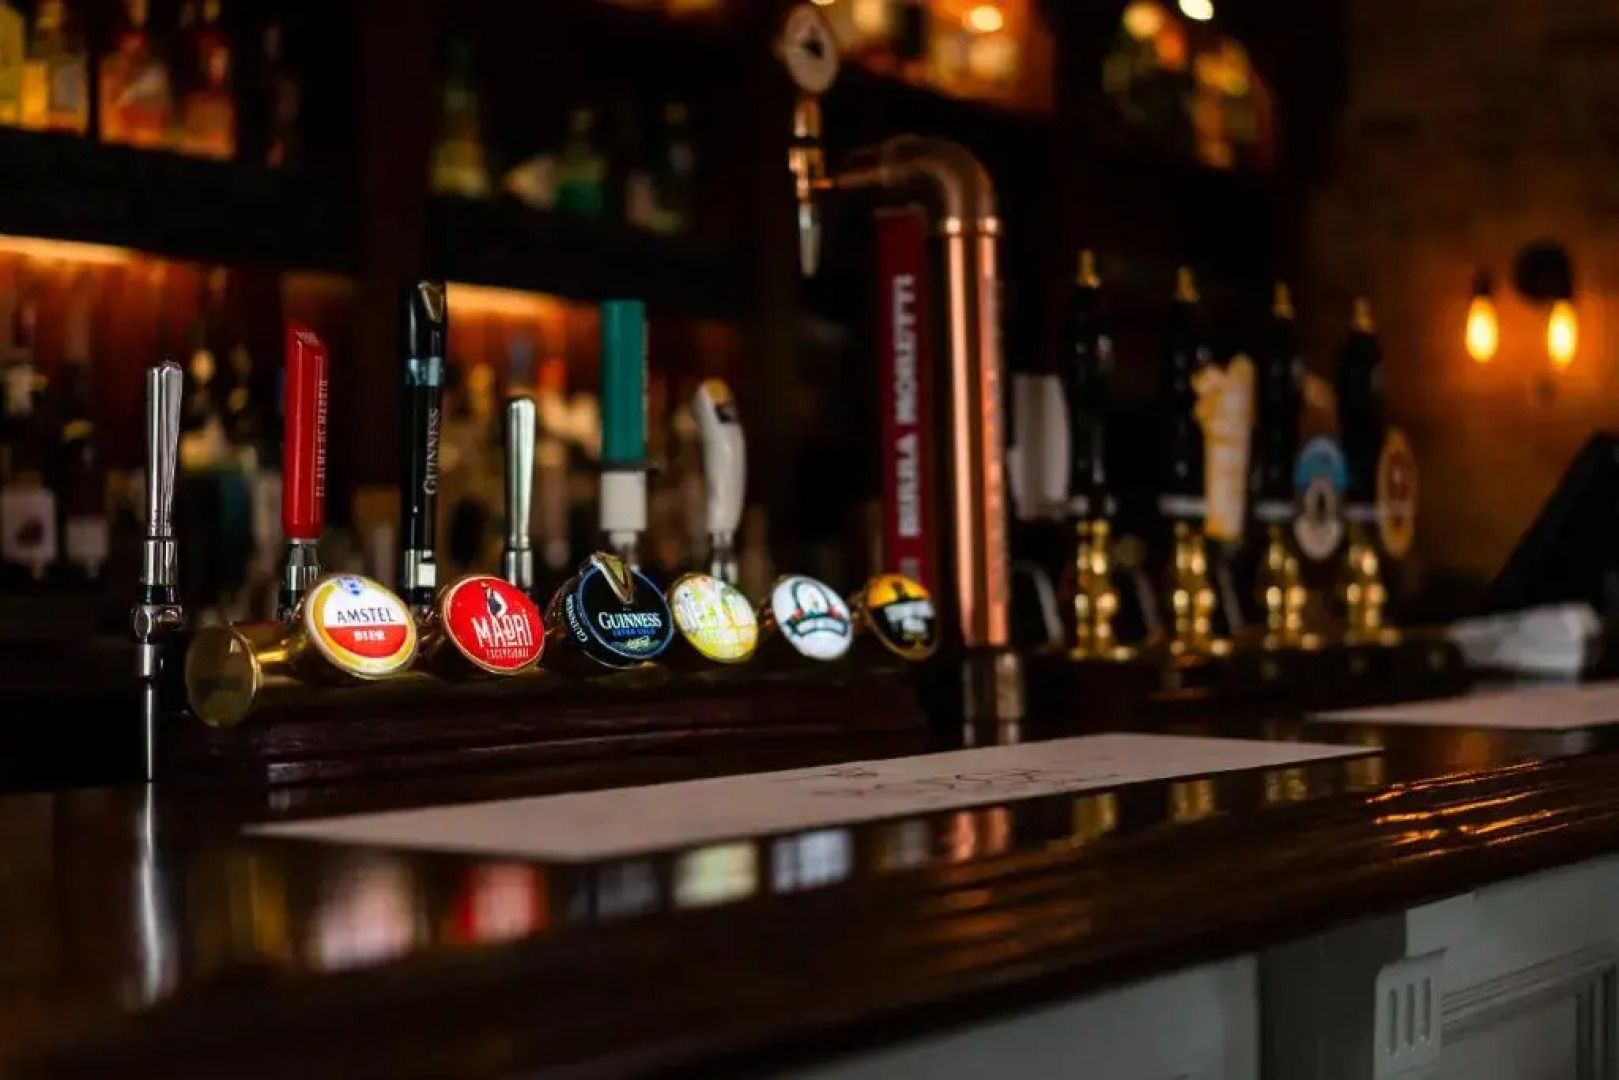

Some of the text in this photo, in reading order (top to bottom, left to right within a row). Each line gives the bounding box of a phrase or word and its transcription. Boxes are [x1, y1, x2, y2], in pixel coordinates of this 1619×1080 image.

[423, 407, 440, 495] GUINNESS
[336, 606, 398, 624] AMSTEL
[565, 594, 588, 643] GUINNESS
[599, 611, 662, 629] GUINNESS
[353, 630, 386, 643] BIER
